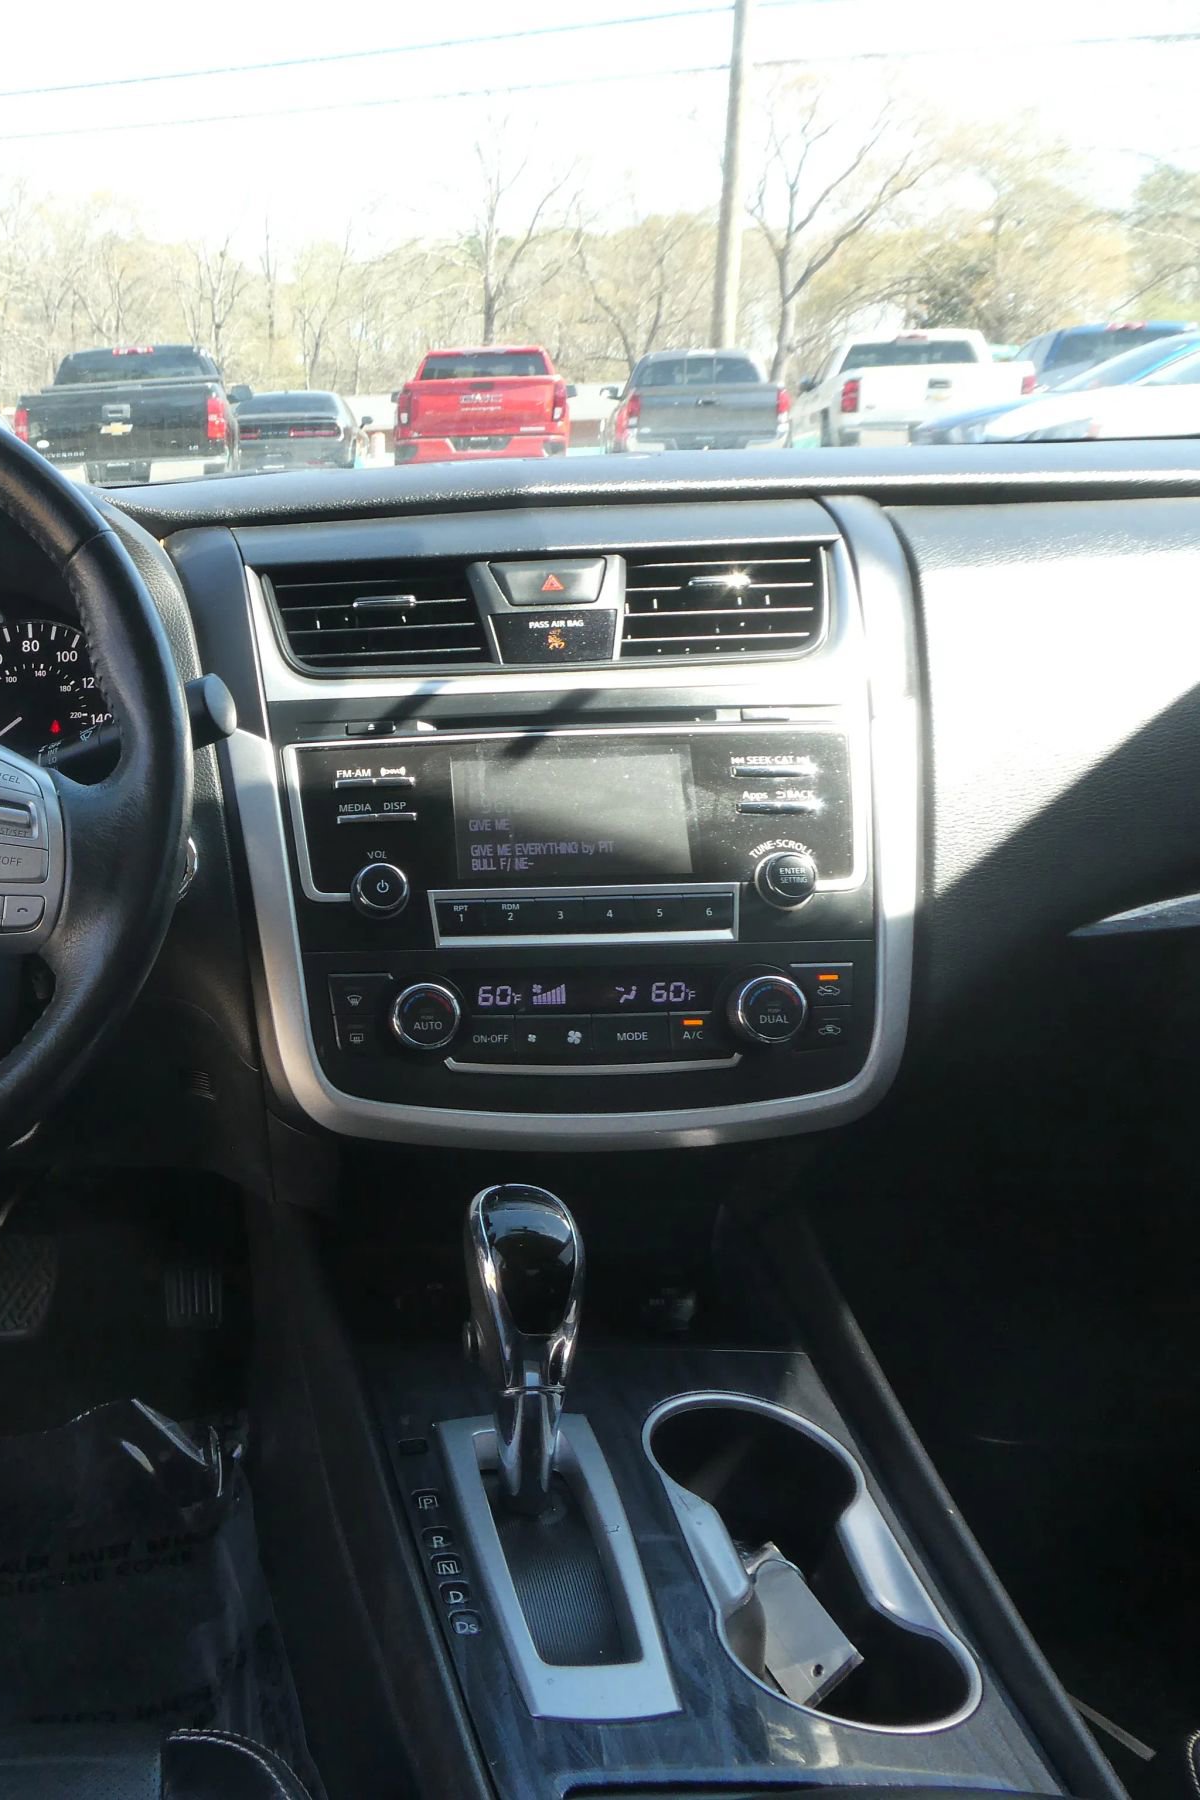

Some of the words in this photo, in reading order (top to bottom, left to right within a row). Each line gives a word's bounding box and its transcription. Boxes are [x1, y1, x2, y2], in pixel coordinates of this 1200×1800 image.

[551, 620, 566, 628] AIR
[22, 640, 40, 652] 80
[56, 651, 78, 662] 100
[82, 677, 95, 689] 12
[742, 791, 768, 800] Apps
[787, 790, 814, 799] BACK
[339, 803, 372, 812] MEDIA
[384, 802, 406, 810] DISP
[469, 820, 492, 831] GIVE
[495, 818, 510, 830] ME
[471, 844, 494, 856] GIVE
[498, 844, 512, 855] ME
[516, 842, 578, 854] EVERYTHING
[582, 842, 595, 855] by
[598, 840, 614, 852] PIT
[472, 858, 496, 870] BULL
[508, 912, 514, 920] 2
[558, 911, 564, 920] 3
[606, 910, 613, 918] 4
[657, 908, 663, 917] 5
[706, 908, 712, 916] 6
[459, 914, 464, 922] 1
[759, 1014, 789, 1024] DUAL
[414, 1022, 442, 1030] AUTO
[617, 1032, 648, 1040] MODE
[683, 1031, 703, 1040] A/C
[432, 1536, 444, 1548] R
[450, 1591, 463, 1603] D
[456, 1621, 478, 1634] Ds
